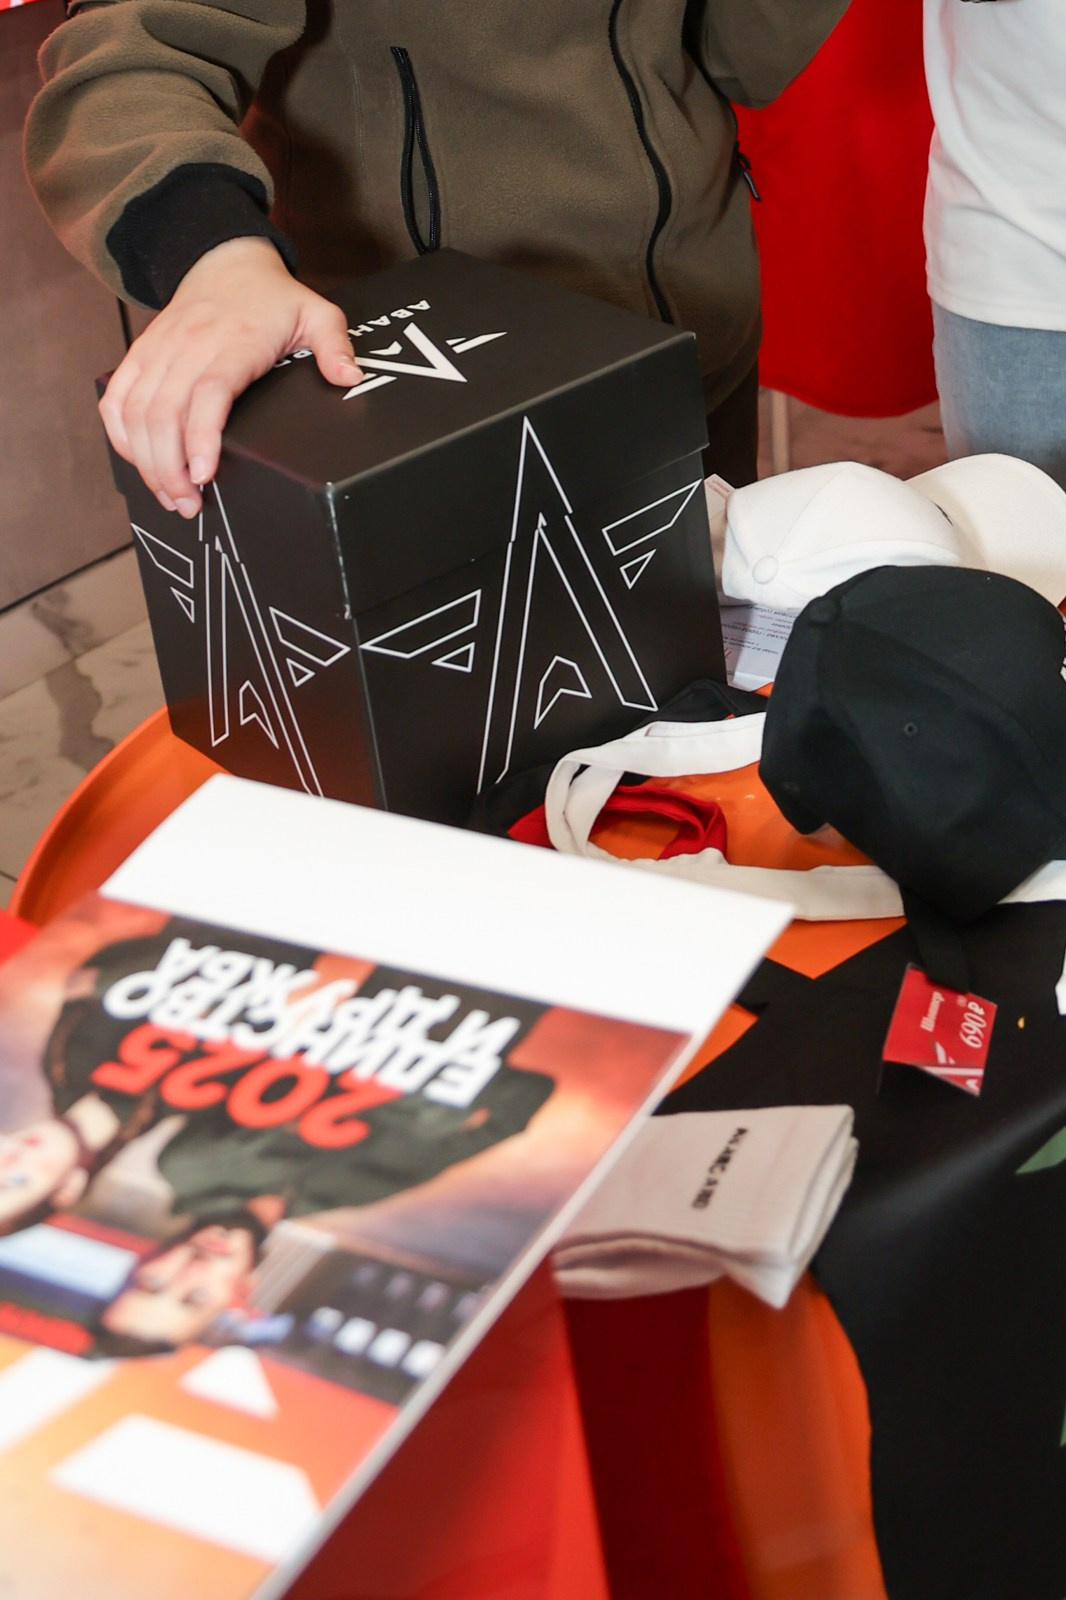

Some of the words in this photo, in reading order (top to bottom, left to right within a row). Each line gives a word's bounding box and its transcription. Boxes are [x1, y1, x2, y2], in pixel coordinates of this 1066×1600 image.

[103, 970, 503, 1108] ЕДИНСТВО
[153, 937, 461, 1042] ДРУЖБА
[91, 1022, 404, 1149] 2025
